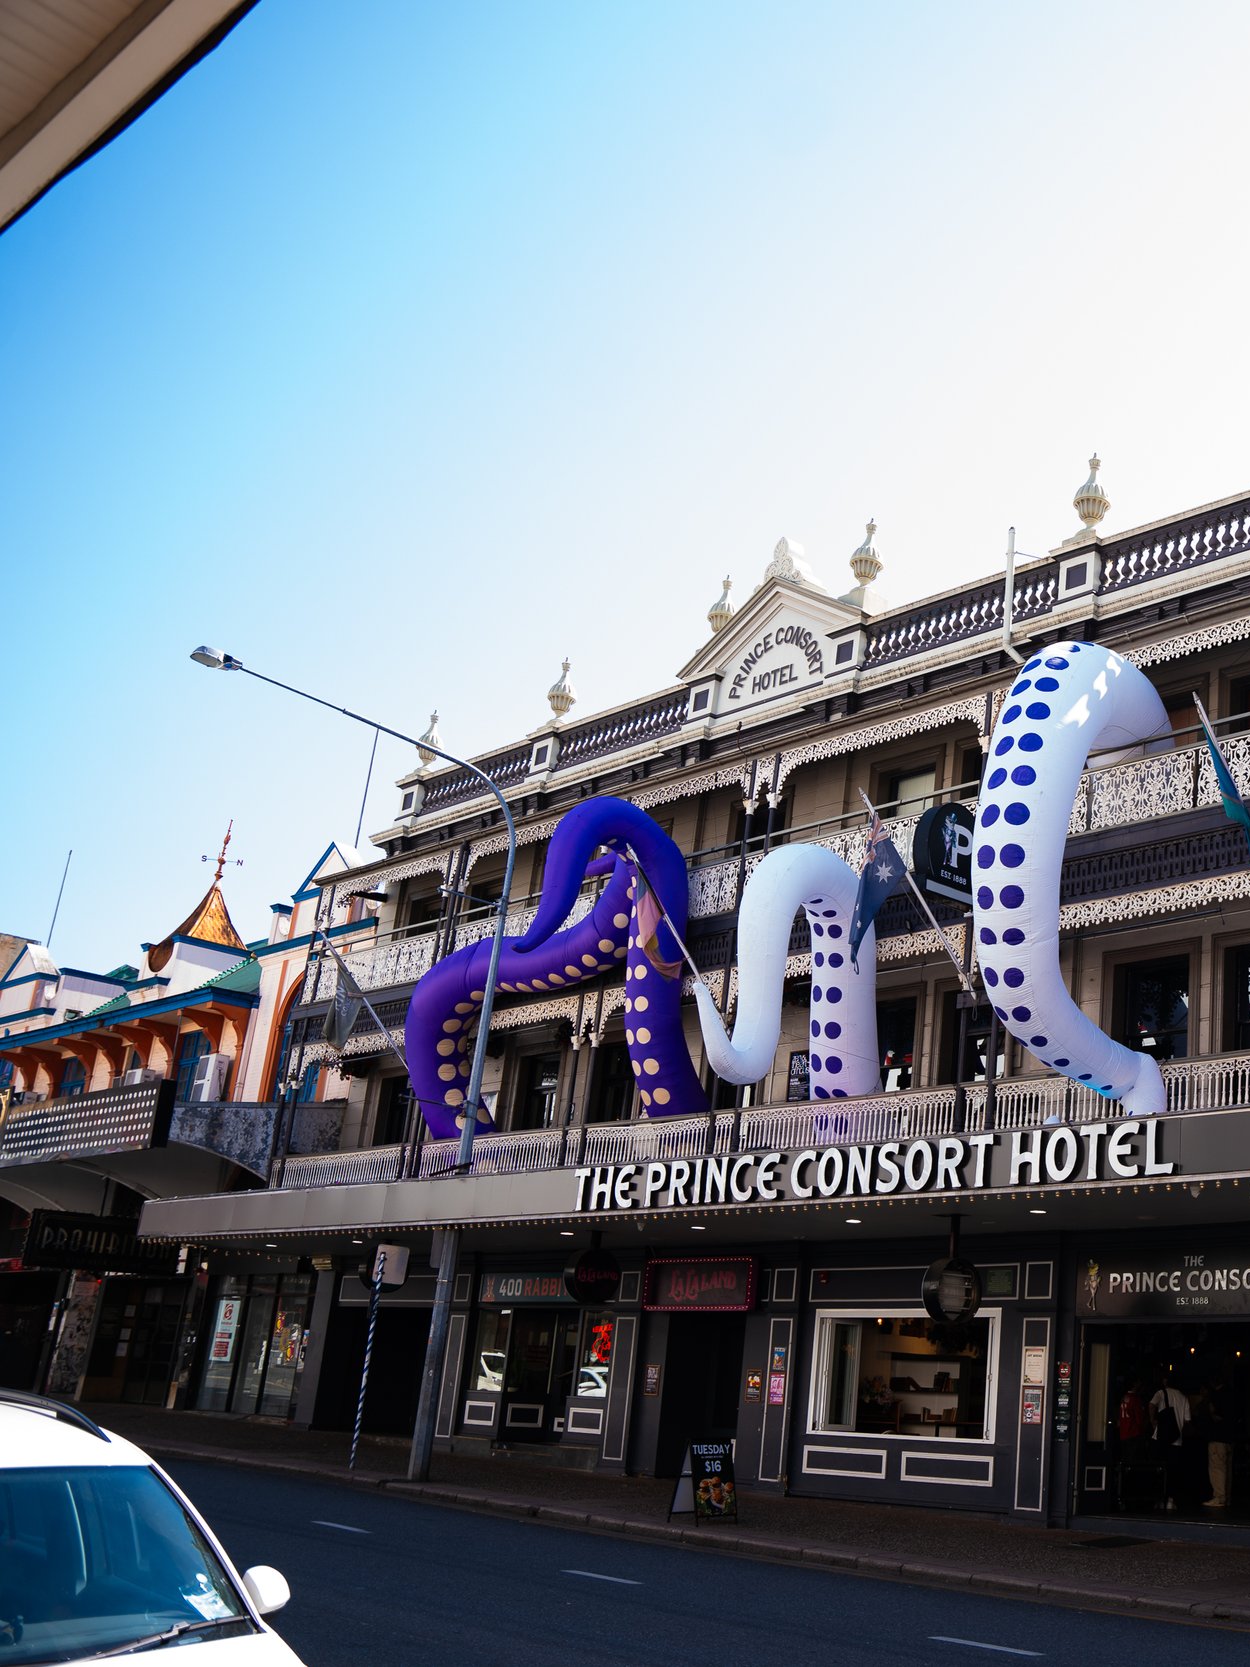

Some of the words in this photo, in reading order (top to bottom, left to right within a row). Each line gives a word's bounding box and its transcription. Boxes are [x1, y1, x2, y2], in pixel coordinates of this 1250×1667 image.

[728, 632, 774, 699] PRINCE
[775, 625, 824, 675] CONSORT
[751, 664, 798, 695] HOTEL
[953, 873, 968, 886] 1888
[574, 1164, 637, 1213] THE
[644, 1152, 782, 1208] PRINCE
[790, 1134, 994, 1199] CONSORT
[1009, 1119, 1174, 1185] HOTEL
[1183, 1256, 1205, 1267] THE
[499, 1278, 523, 1297] 400
[524, 1276, 567, 1298] RABBI
[701, 1270, 736, 1292] LAND
[1109, 1271, 1182, 1294] PRINCE
[1191, 1297, 1209, 1305] 1888
[692, 1444, 730, 1455] TUESDAY
[704, 1460, 722, 1473] $16
